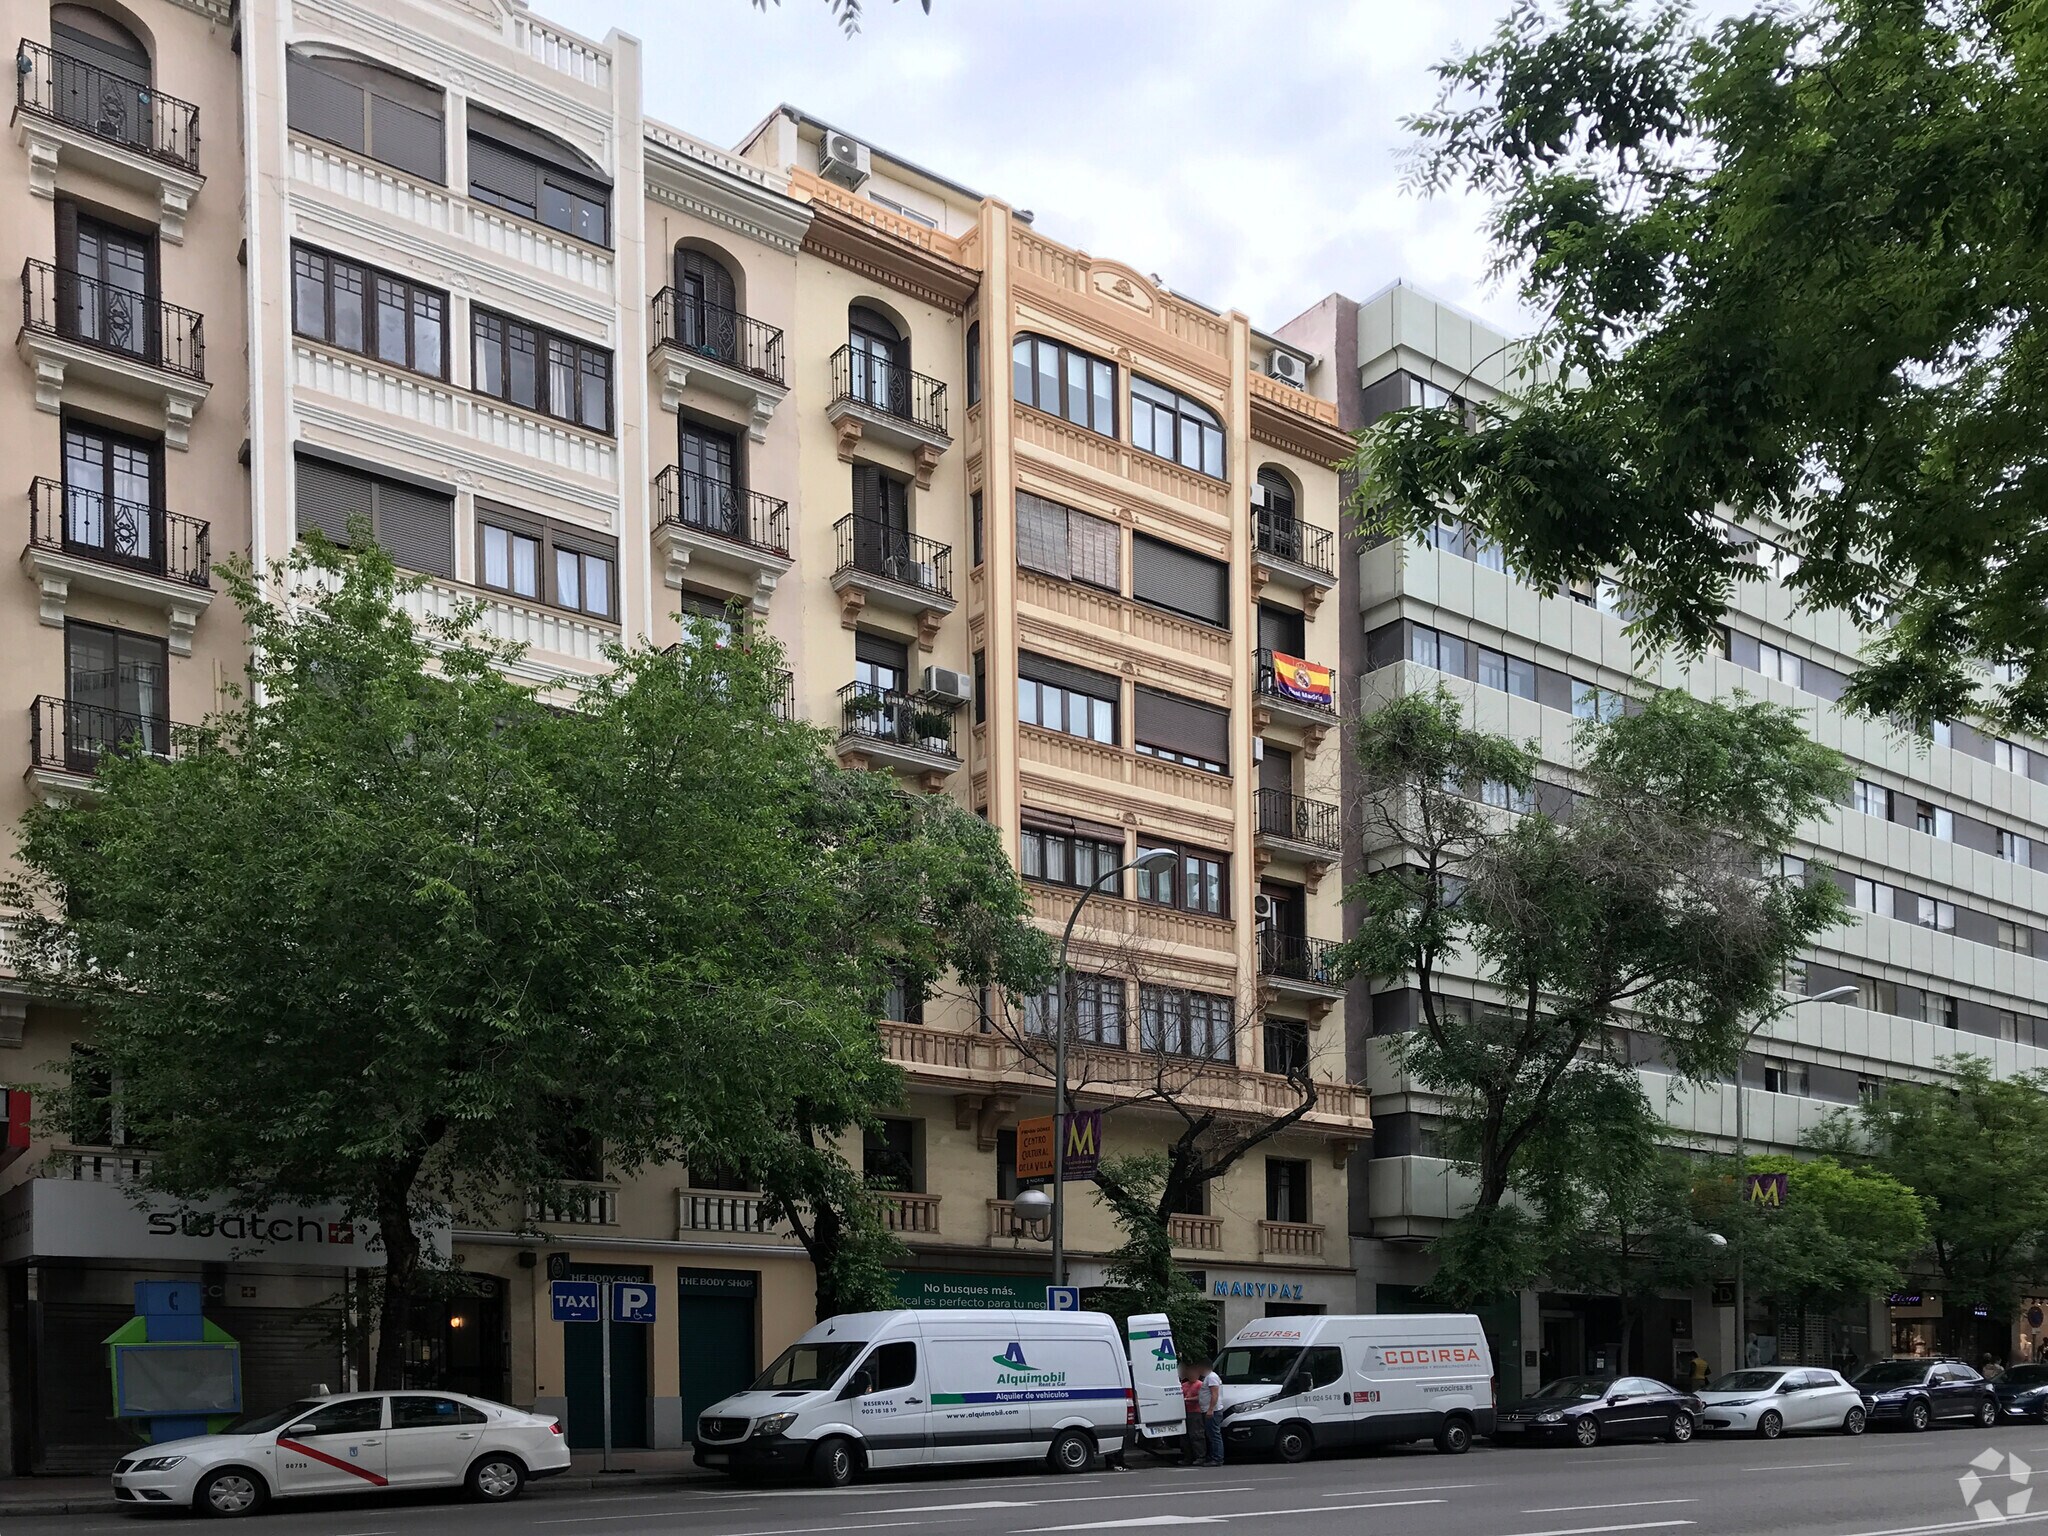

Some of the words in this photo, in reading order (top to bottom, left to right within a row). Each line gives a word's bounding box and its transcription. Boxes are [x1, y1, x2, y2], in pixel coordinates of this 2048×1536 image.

[1023, 1136, 1046, 1147] CENTRO
[1021, 1148, 1049, 1161] CULTURAL
[149, 1213, 323, 1243] swatch
[680, 1277, 699, 1286] THE
[700, 1278, 726, 1287] BODY
[924, 1284, 940, 1293] No
[943, 1285, 989, 1297] busques
[991, 1286, 1016, 1296] más.
[1214, 1280, 1304, 1299] MARYPAZ
[555, 1295, 596, 1308] TAXI
[622, 1287, 648, 1317] P
[924, 1298, 936, 1306] es
[939, 1297, 985, 1309] perfecto
[987, 1300, 1011, 1309] para
[1013, 1300, 1025, 1308] tu
[1027, 1301, 1047, 1310] neg
[1053, 1290, 1073, 1311] P
[1385, 1349, 1480, 1364] COCIRSA
[997, 1372, 1066, 1386] Alquimobil
[1423, 1385, 1473, 1393] www.cocirsa.es
[996, 1392, 1023, 1401] Alquiler
[1026, 1391, 1035, 1399] de
[947, 1410, 1019, 1419] www.alquimobil.com
